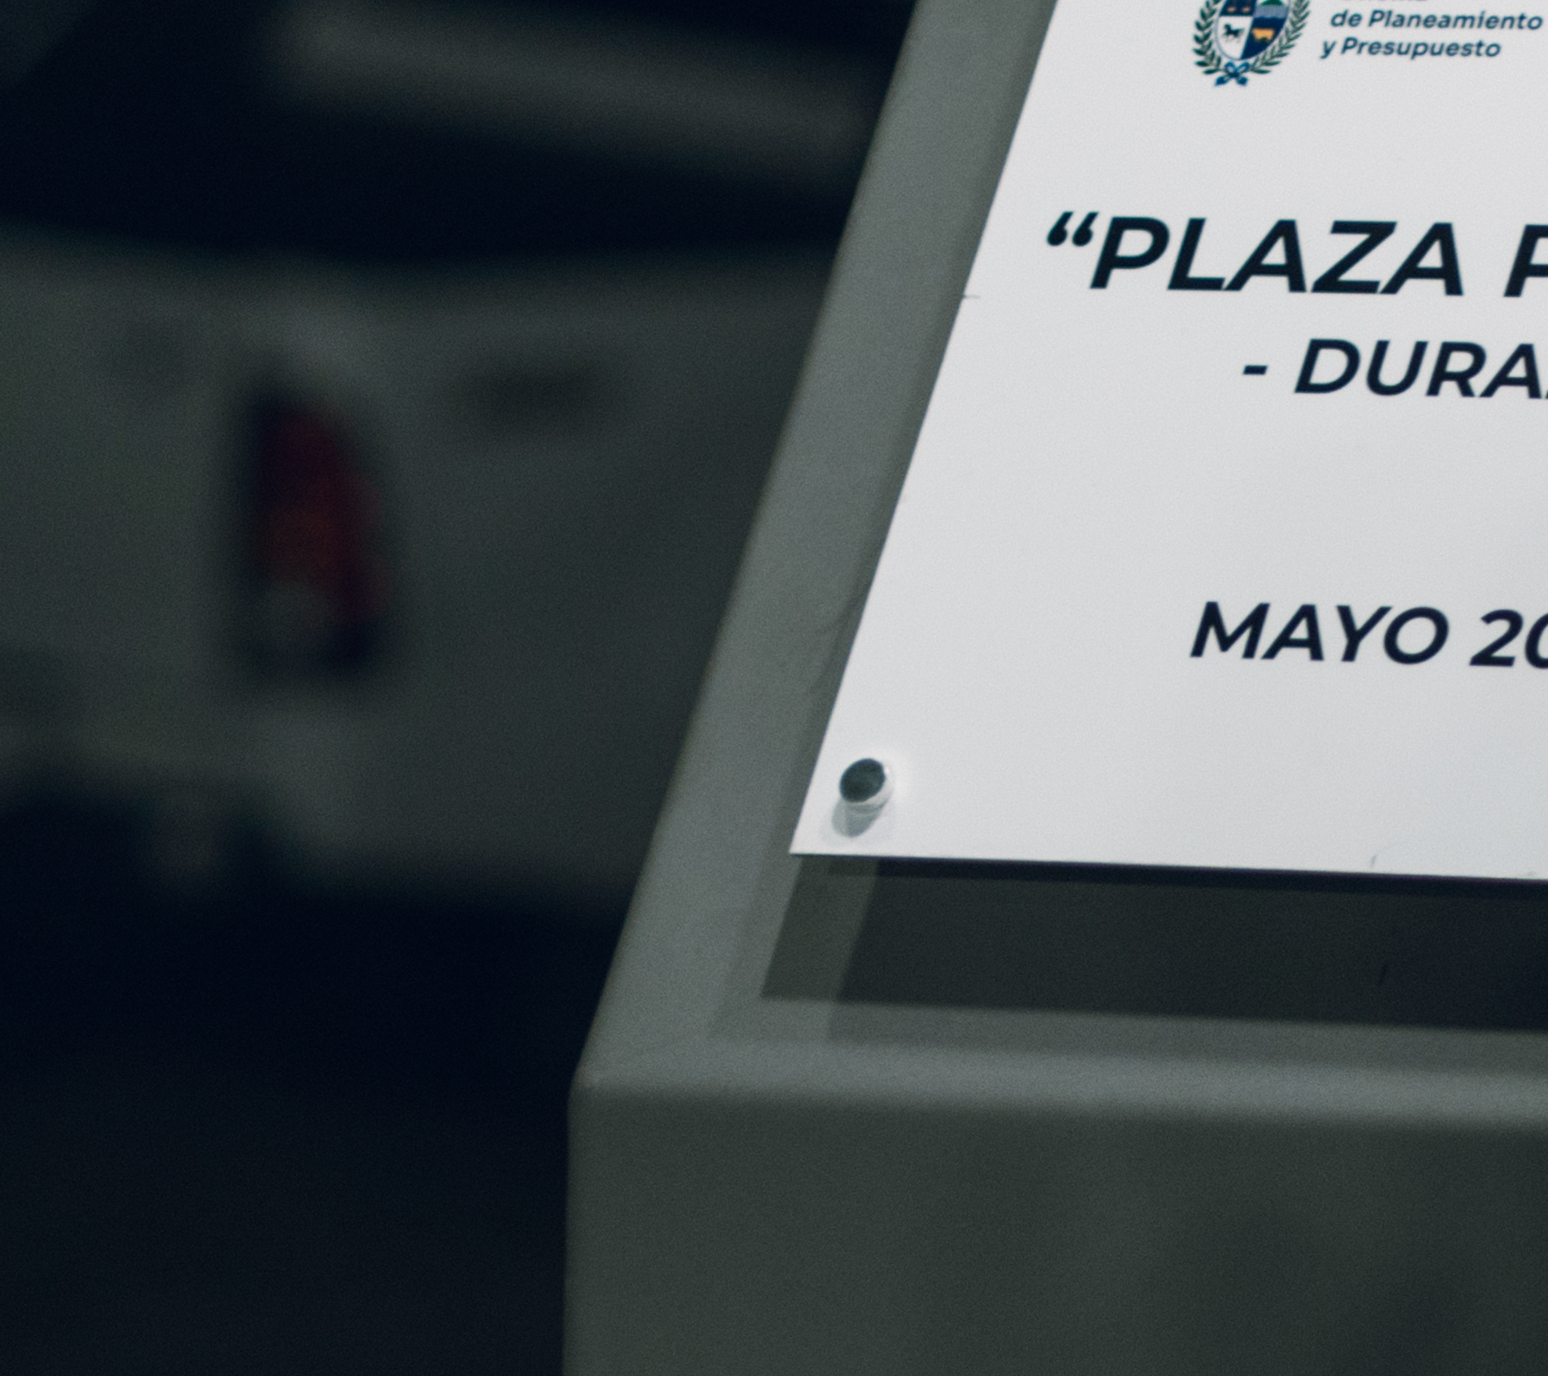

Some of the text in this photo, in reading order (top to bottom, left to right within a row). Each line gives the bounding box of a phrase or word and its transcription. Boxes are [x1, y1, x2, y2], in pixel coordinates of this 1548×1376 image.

[1329, 8, 1544, 31] de Planeamiento
[1319, 35, 1502, 61] y Presupuesto
[1045, 210, 1465, 297] “PLAZA
[1189, 600, 1451, 666] MAYO
